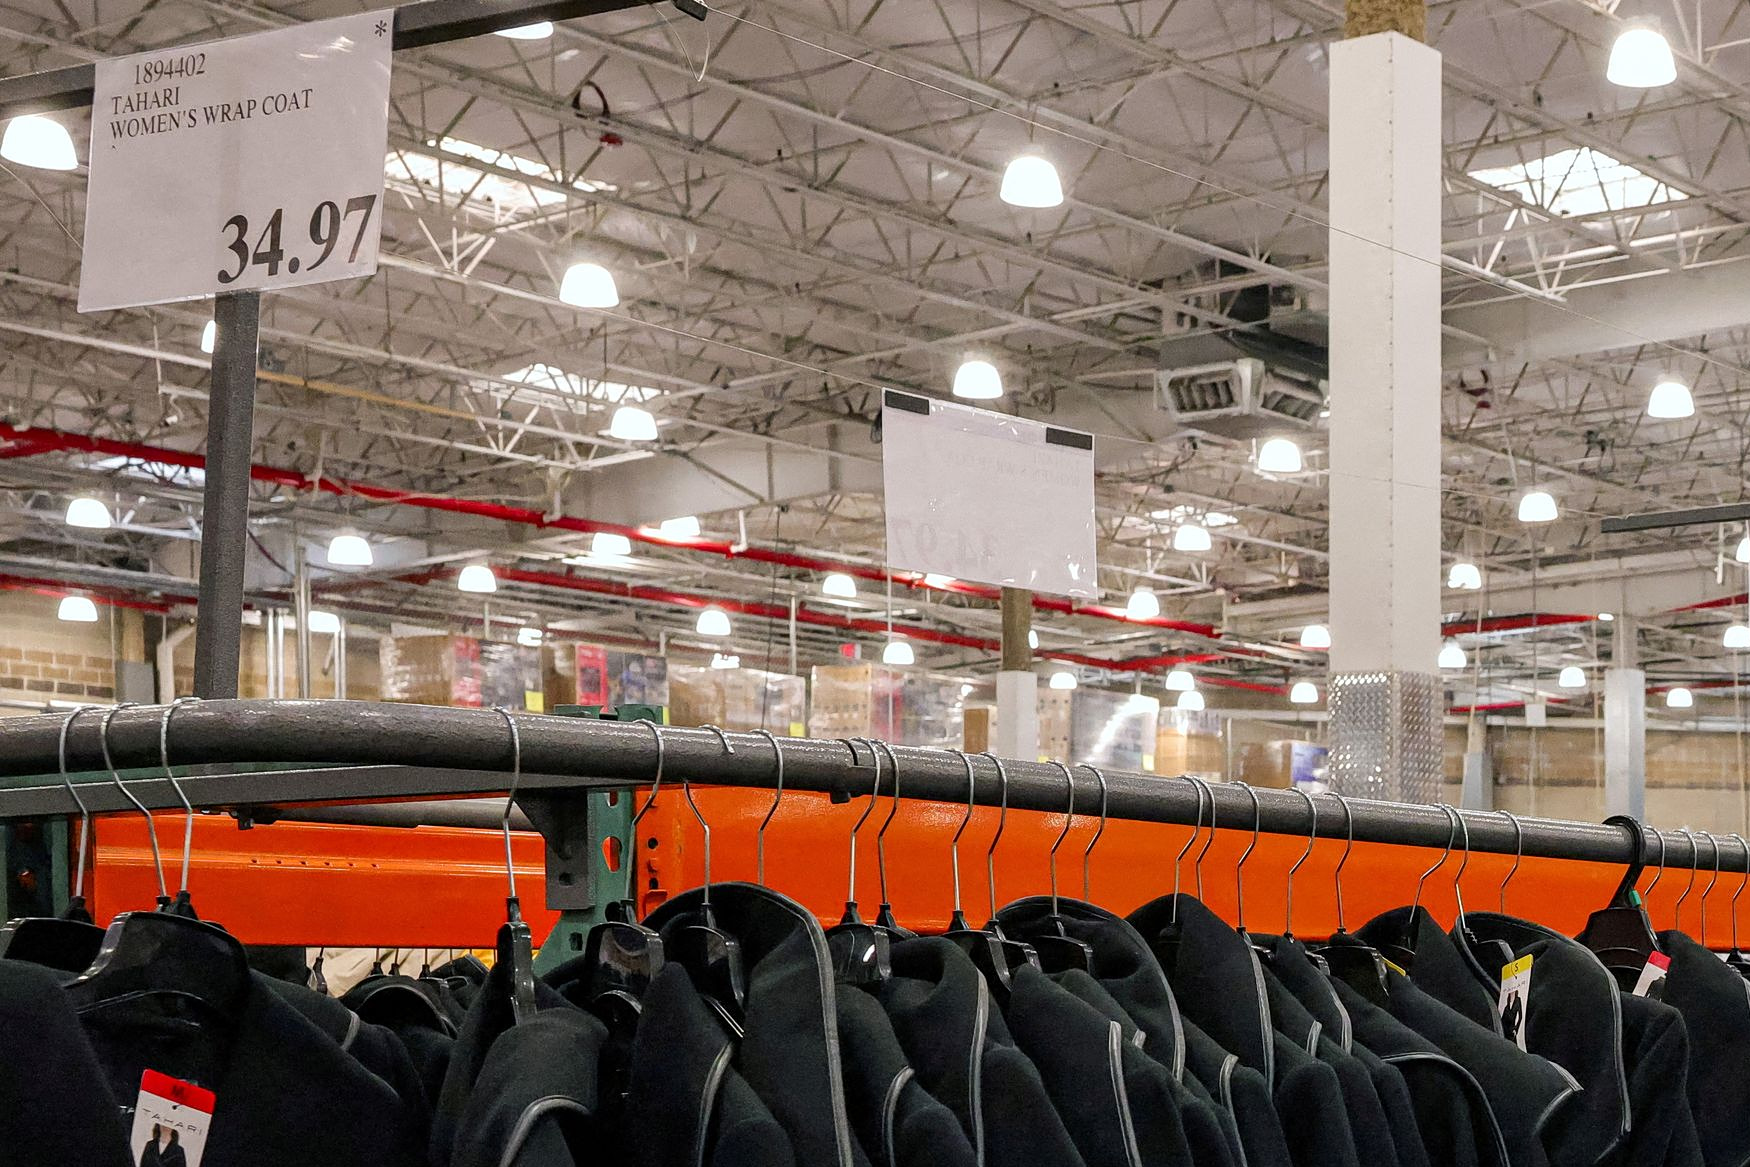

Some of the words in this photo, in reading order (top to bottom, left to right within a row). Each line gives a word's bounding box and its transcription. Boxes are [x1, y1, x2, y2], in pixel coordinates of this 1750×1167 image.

[135, 53, 206, 85] 1894402
[110, 108, 198, 140] WOMEN'S
[203, 99, 257, 125] WRAP
[262, 88, 313, 116] COAT
[111, 87, 180, 115] TAHARI
[217, 194, 377, 284] 34.97
[142, 1108, 202, 1135] TAHARI
